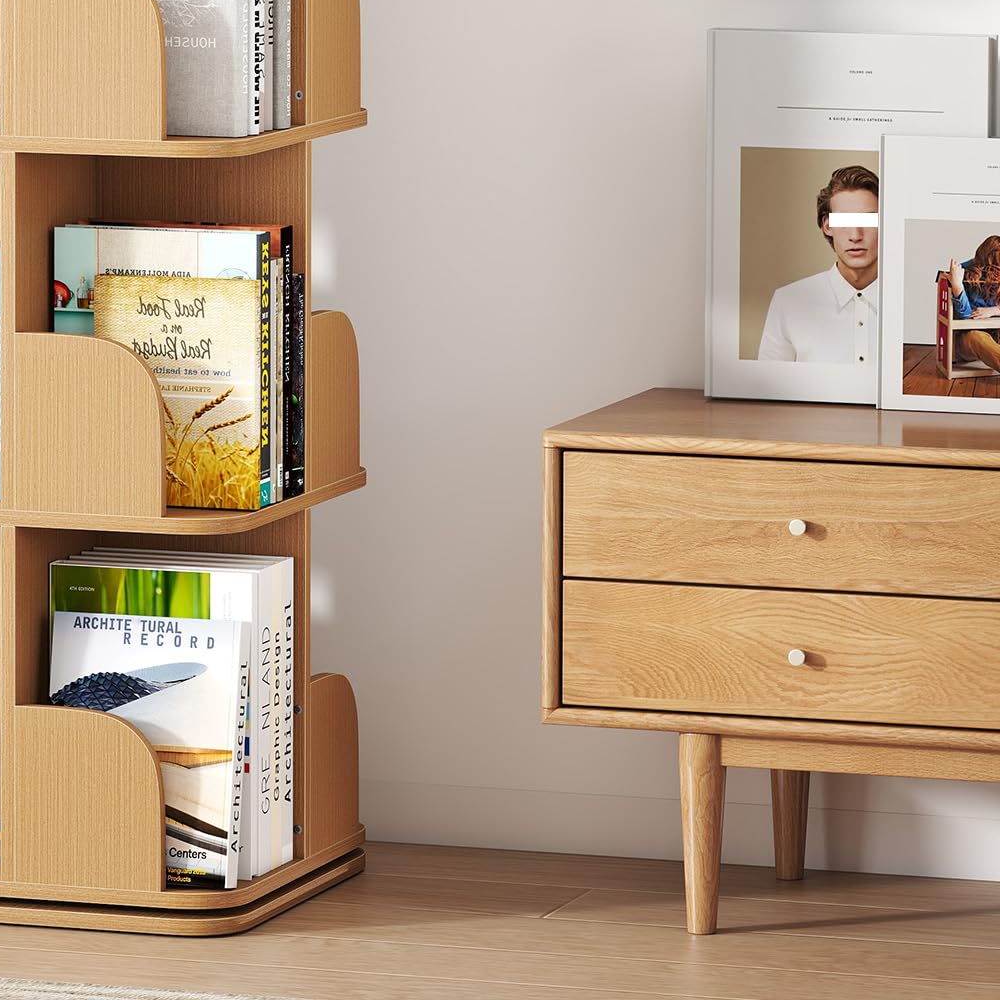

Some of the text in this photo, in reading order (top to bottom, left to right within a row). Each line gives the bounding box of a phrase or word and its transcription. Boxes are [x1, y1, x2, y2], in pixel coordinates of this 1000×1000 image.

[73, 616, 182, 635] ARCHITE TURAL
[284, 599, 292, 803] Architectural
[230, 660, 248, 852] Architectural
[169, 847, 207, 860] Centers
